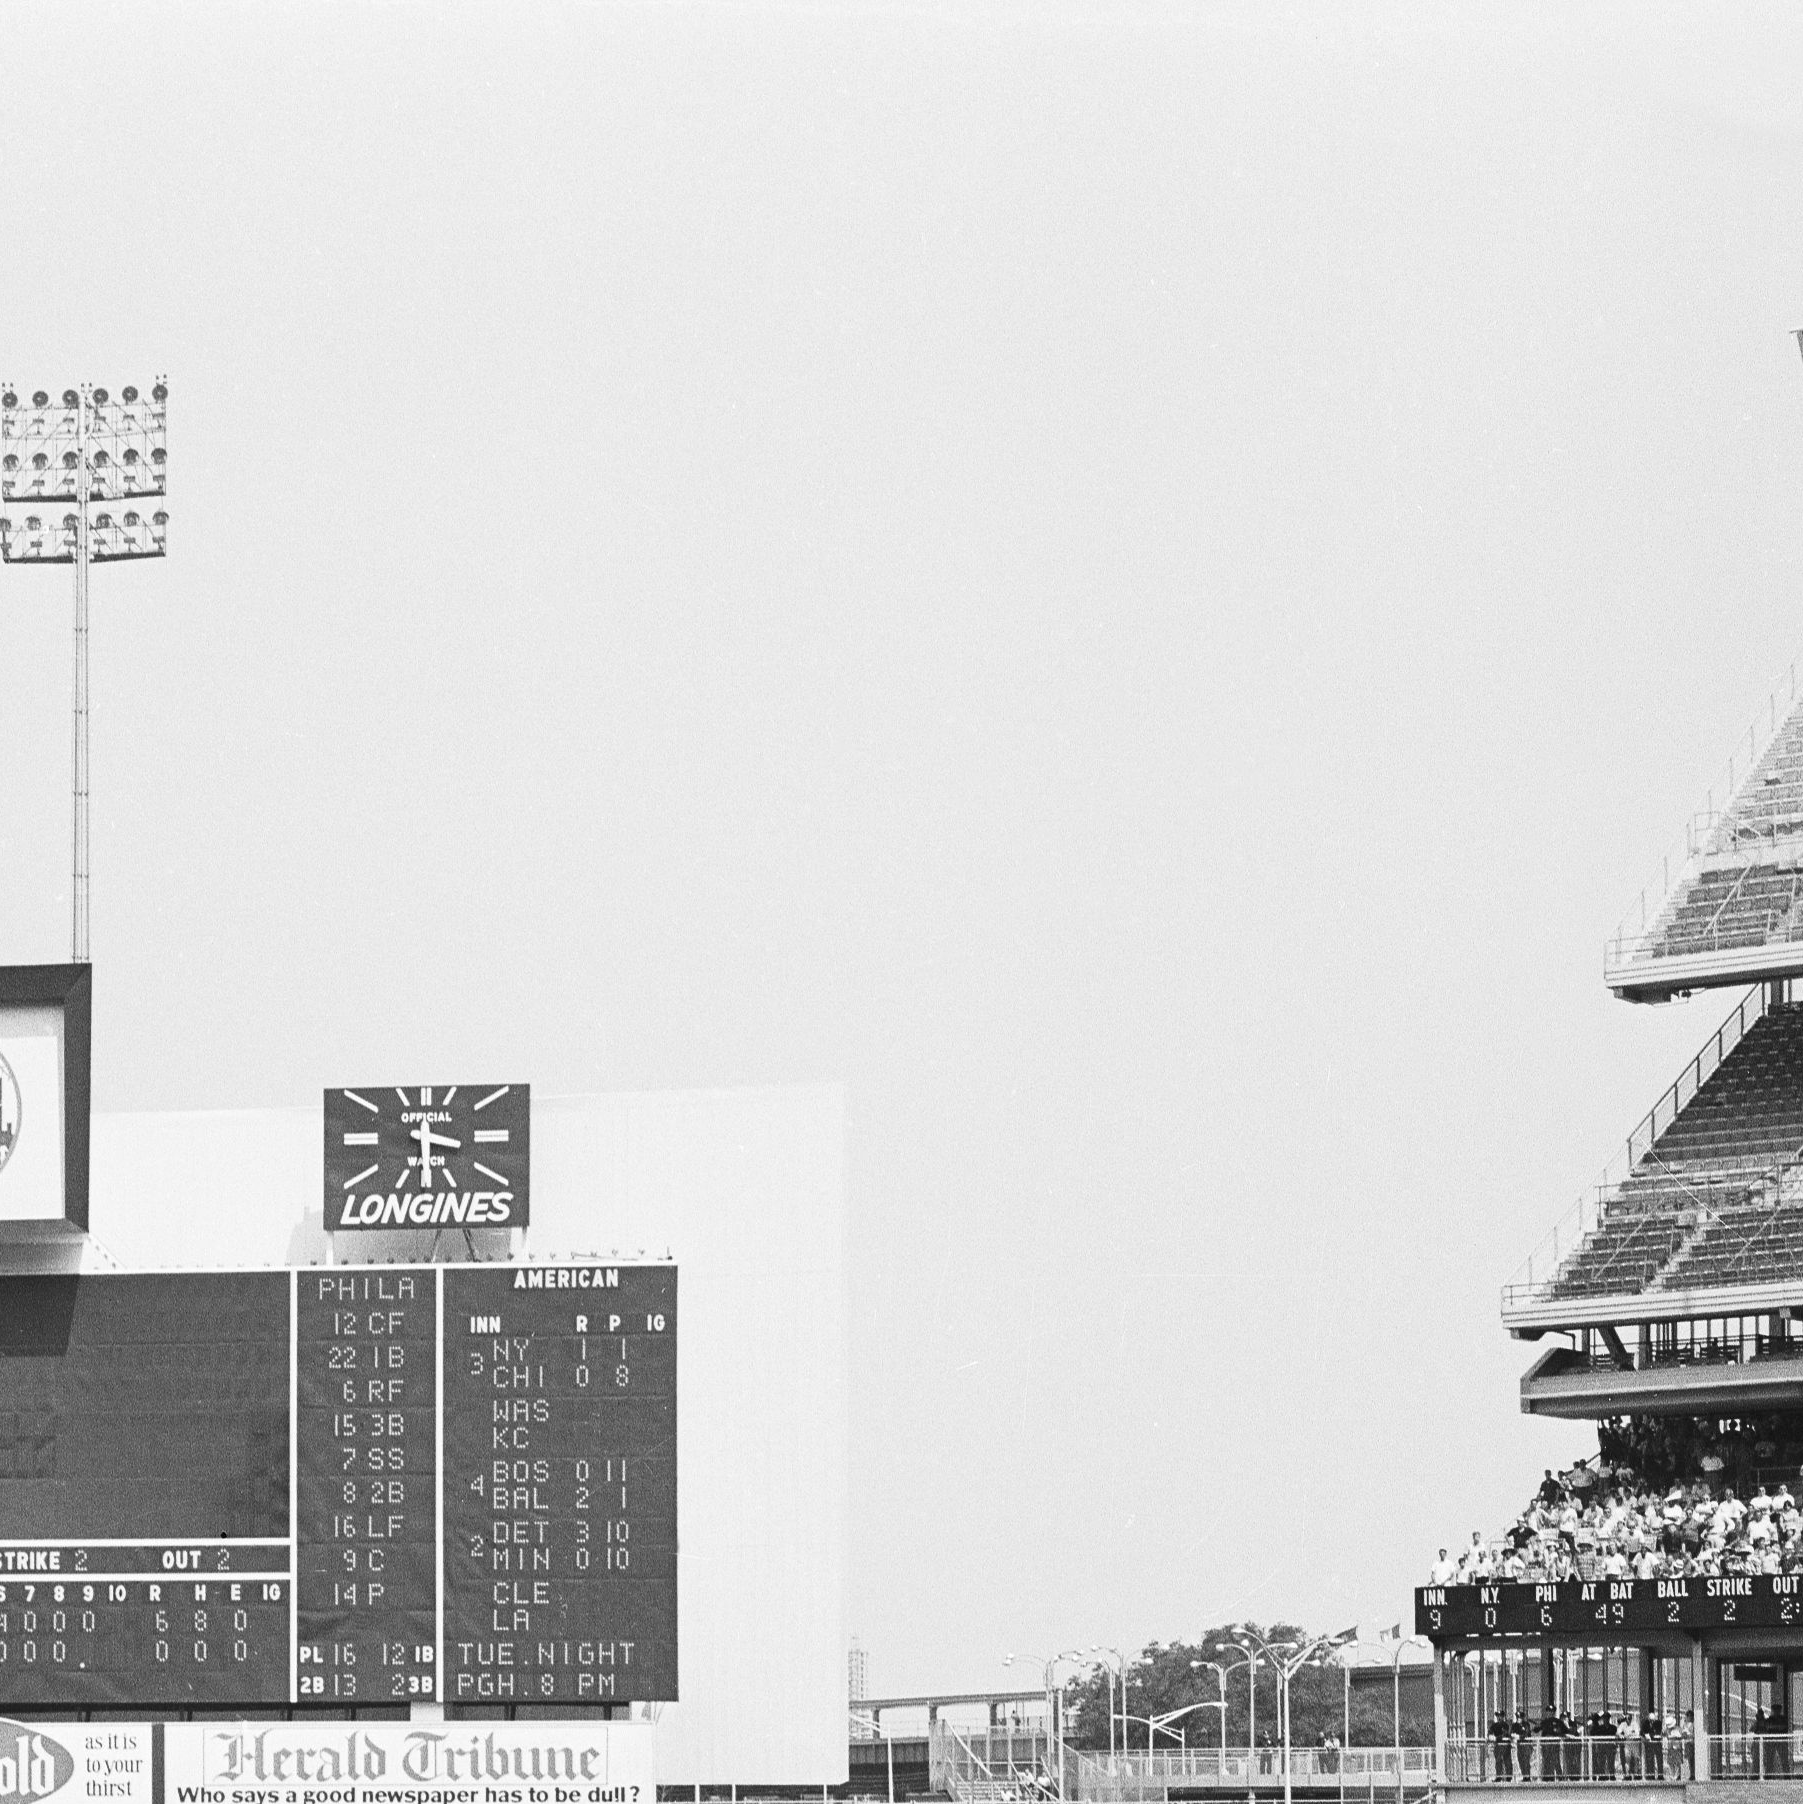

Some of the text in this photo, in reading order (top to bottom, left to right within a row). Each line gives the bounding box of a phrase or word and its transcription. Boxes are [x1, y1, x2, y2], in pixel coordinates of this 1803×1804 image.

[401, 1112, 452, 1123] OFFICIAL
[408, 1156, 445, 1166] WACH
[340, 1192, 513, 1224] LONGINES
[319, 1276, 415, 1301] PHILA
[513, 1268, 619, 1289] AMERICAN
[334, 1311, 405, 1335] 12 CF
[470, 1314, 621, 1334] INN R P
[328, 1345, 404, 1369] 22 1B
[493, 1338, 529, 1362] NY
[493, 1365, 544, 1389] CHI
[368, 1379, 404, 1403] RF
[493, 1399, 549, 1422] WAS
[334, 1413, 404, 1437] 15 3B
[493, 1426, 529, 1449] KC
[368, 1447, 404, 1470] SS
[493, 1460, 549, 1483] BOS
[371, 1481, 404, 1504] 2B
[493, 1486, 549, 1510] BAL
[334, 1515, 404, 1538] 16 LF
[607, 1520, 629, 1543] 10
[74, 1549, 88, 1572] 2
[162, 1548, 230, 1571] OUT 2
[368, 1549, 385, 1572] C
[493, 1547, 629, 1571] MIN 10
[108, 1583, 241, 1602] 10 R H E
[334, 1583, 384, 1606] 14 P
[493, 1581, 550, 1605] CLE
[1535, 1584, 1557, 1603] PHI
[1581, 1583, 1597, 1601] AT
[1610, 1581, 1634, 1600] BAT
[1657, 1579, 1689, 1599] BALL
[1706, 1577, 1753, 1597] STRIKE
[1772, 1575, 1800, 1594] OUT
[493, 1608, 530, 1631] LA
[1429, 1609, 1441, 1630] 9
[1540, 1605, 1553, 1627] 6
[1667, 1601, 1680, 1623] 2
[1723, 1599, 1736, 1621] 2
[299, 1646, 324, 1664] PL
[334, 1643, 357, 1666] 16
[383, 1642, 405, 1666] 12
[538, 1642, 635, 1666] NIGHT
[300, 1673, 433, 1696] 2B 13 3B
[541, 1673, 554, 1696] 8
[578, 1673, 615, 1696] PM
[85, 1736, 103, 1749] as
[212, 1728, 602, 1783] Herald Tribune
[86, 1760, 143, 1777] to your
[86, 1780, 132, 1797] thirst
[177, 1787, 226, 1803] Who
[285, 1790, 297, 1803] a
[485, 1787, 523, 1803] has
[528, 1787, 549, 1803] to
[554, 1787, 581, 1803] be
